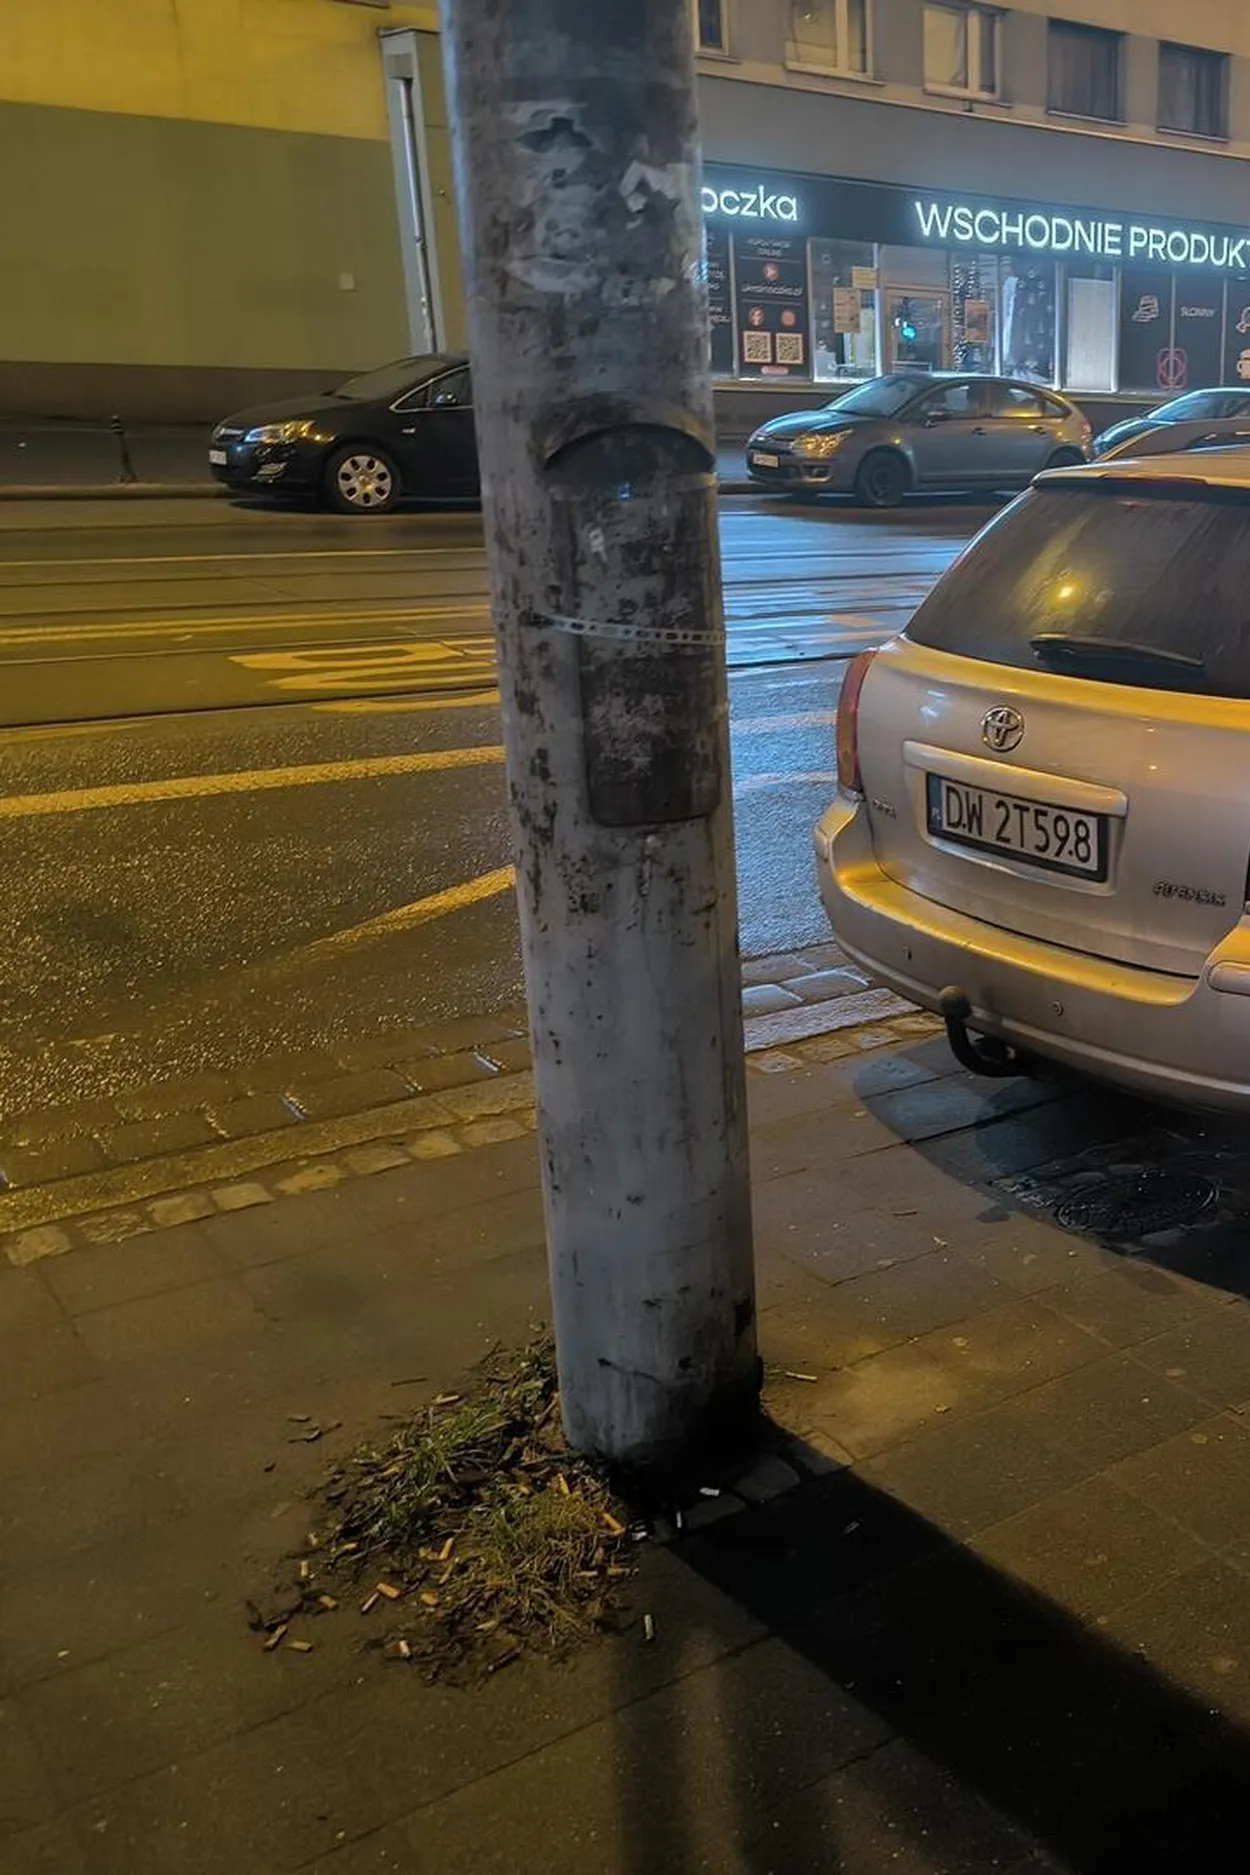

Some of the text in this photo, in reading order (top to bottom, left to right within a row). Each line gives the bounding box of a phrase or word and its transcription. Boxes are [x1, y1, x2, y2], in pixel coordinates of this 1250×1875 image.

[915, 201, 1123, 256] WSCHODNIE
[944, 784, 1092, 864] DW 2T598
